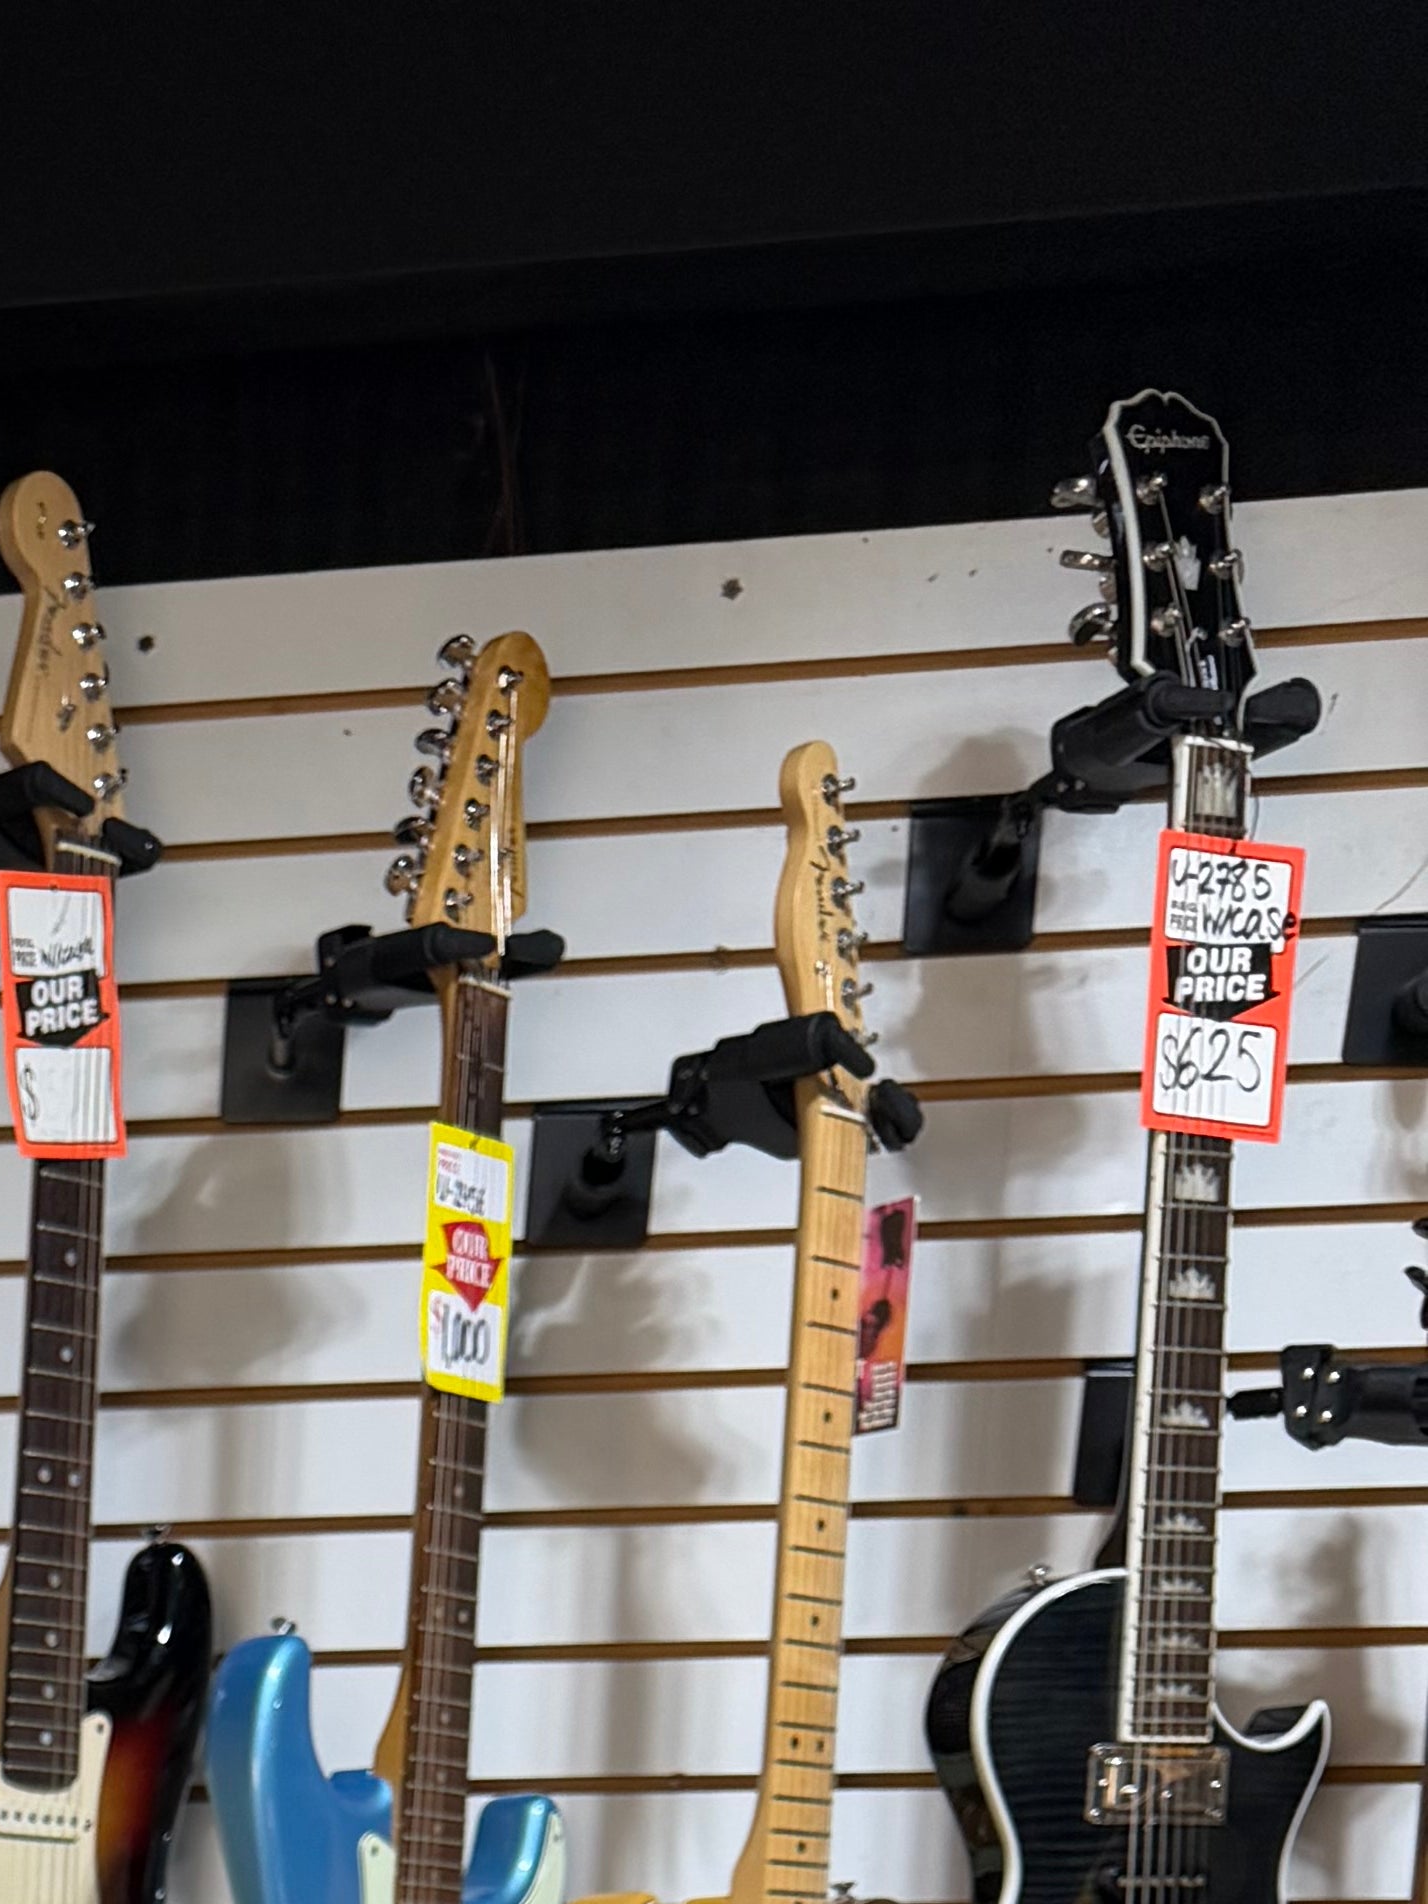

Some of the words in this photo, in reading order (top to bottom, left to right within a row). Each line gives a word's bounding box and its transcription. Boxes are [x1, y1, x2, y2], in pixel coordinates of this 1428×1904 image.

[1124, 424, 1211, 455] Epiphone
[1171, 858, 1272, 901] U-2785
[1187, 947, 1253, 975] OUR
[31, 976, 84, 1008] OUR
[1175, 974, 1267, 1002] PRICE
[25, 998, 99, 1037] PRICE
[1160, 1027, 1263, 1093] $625
[451, 1225, 489, 1260] OUR
[445, 1254, 494, 1290] PRICE
